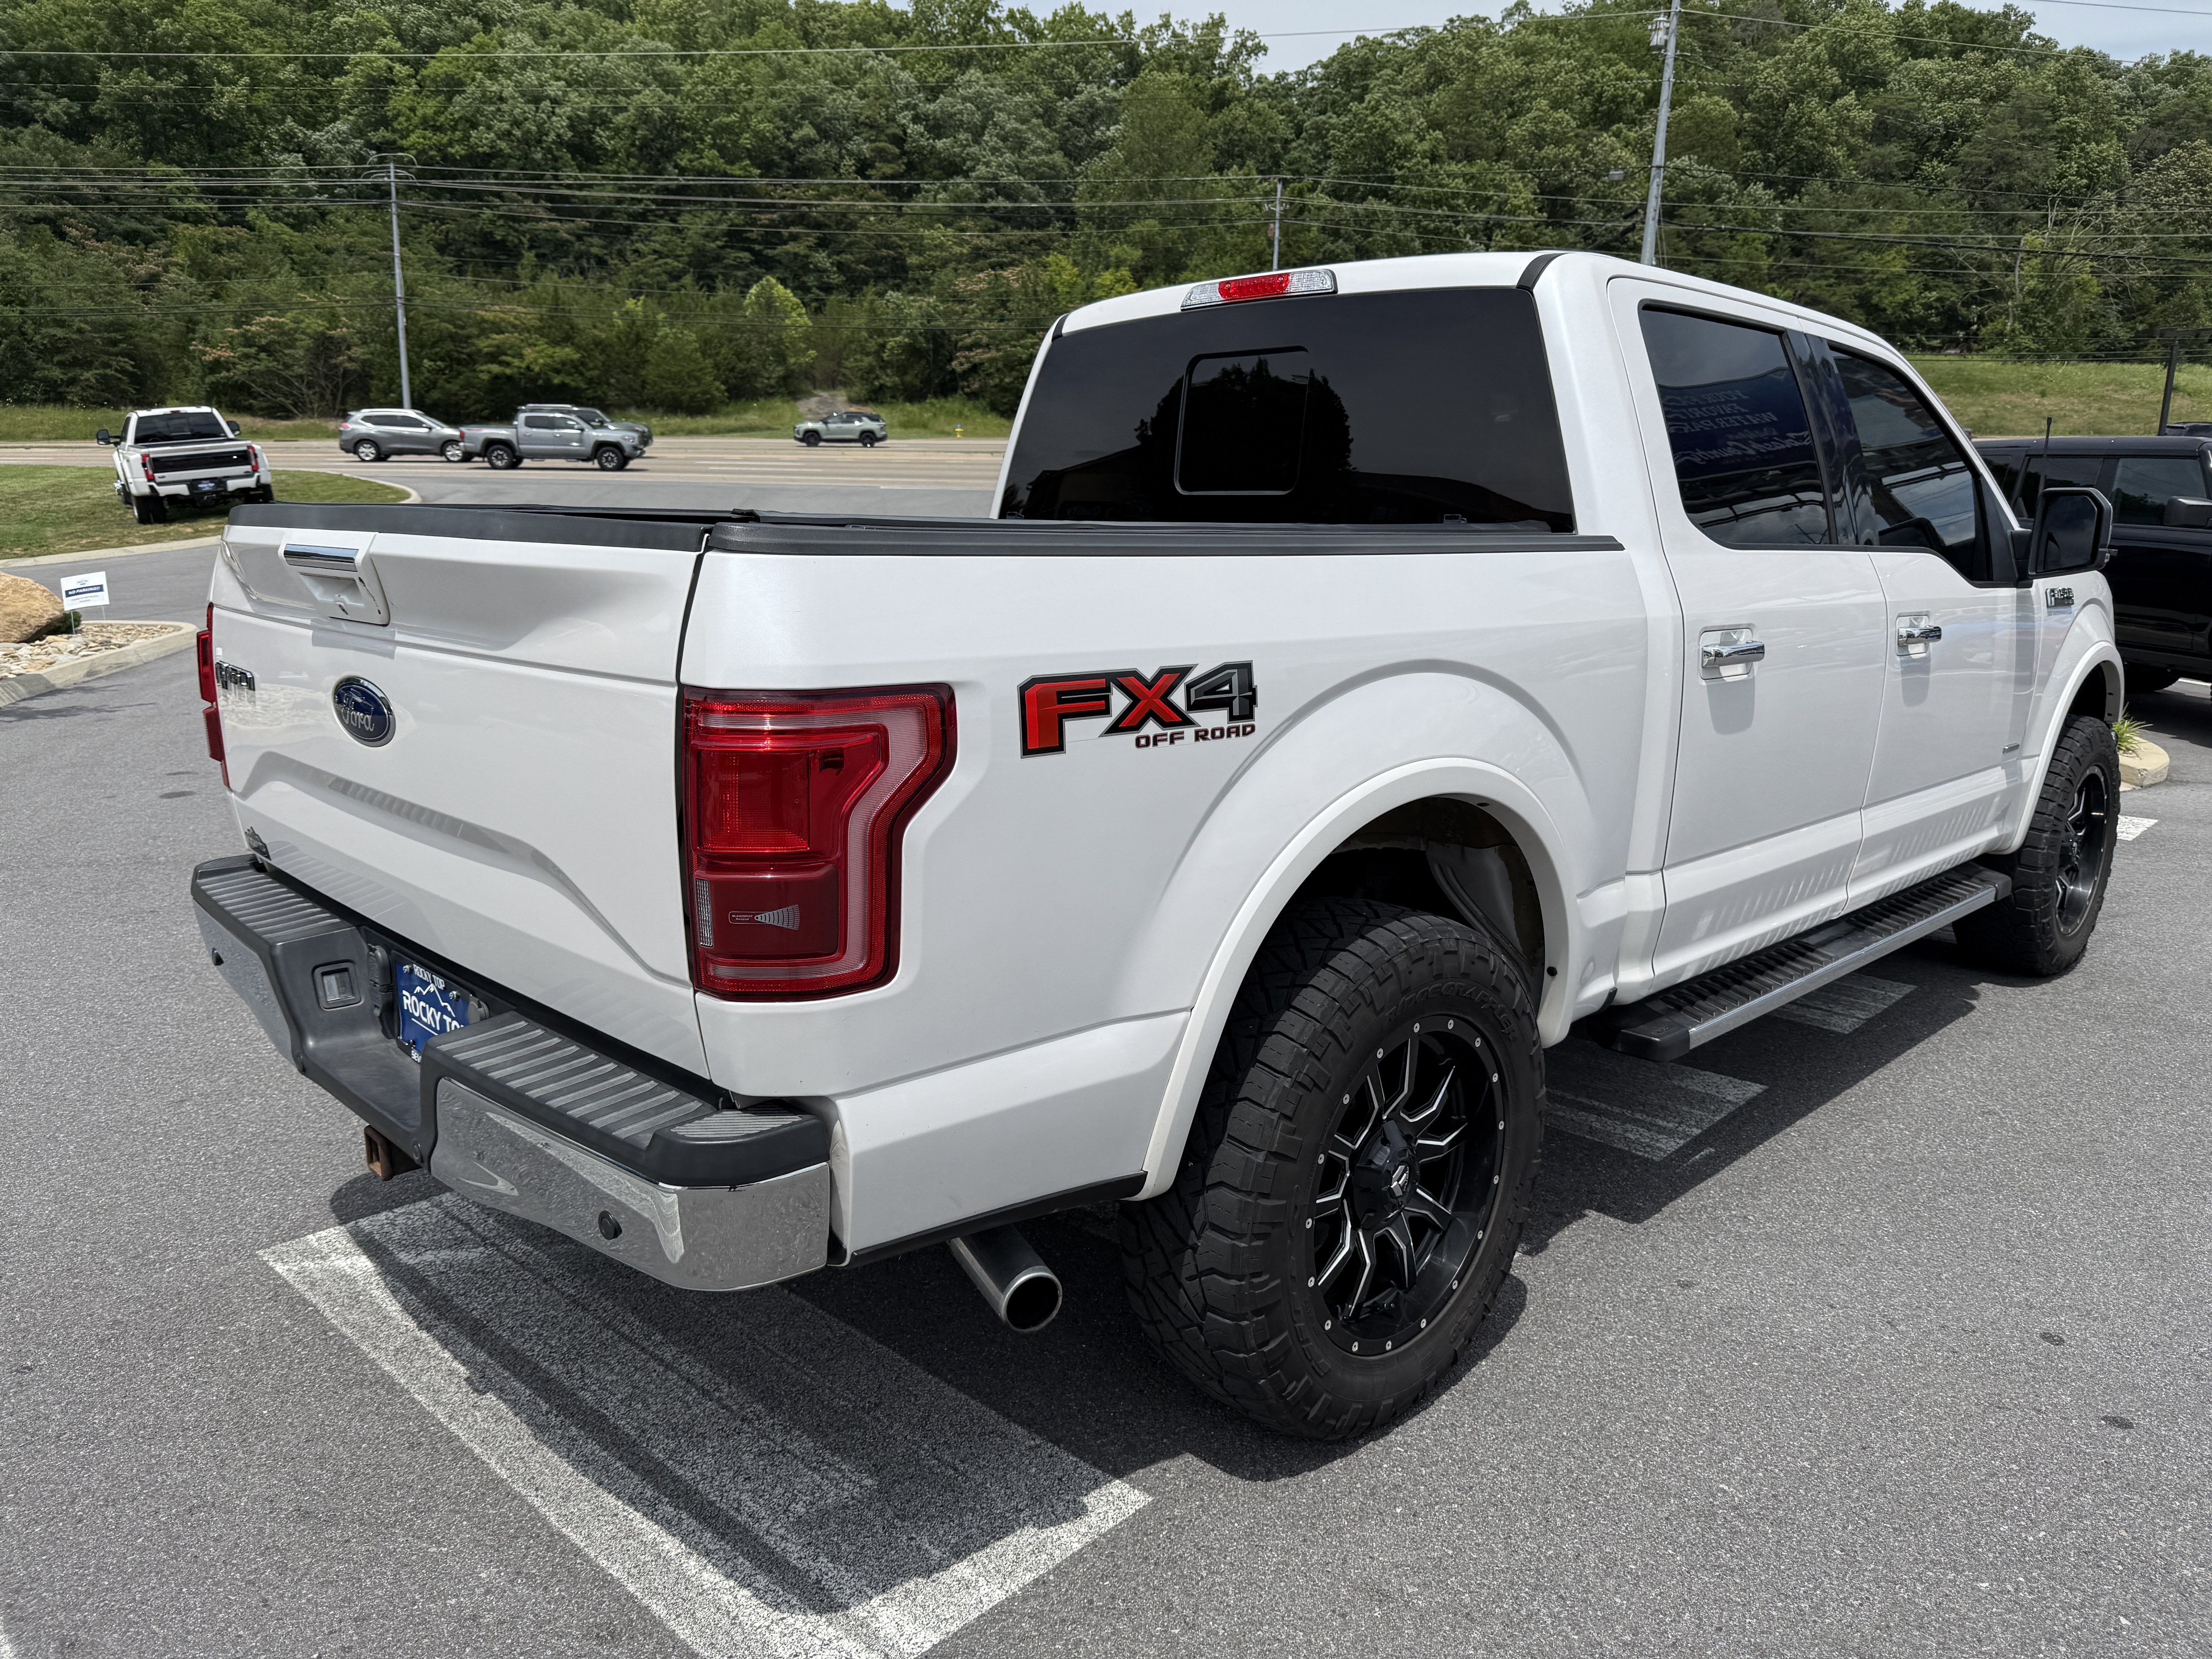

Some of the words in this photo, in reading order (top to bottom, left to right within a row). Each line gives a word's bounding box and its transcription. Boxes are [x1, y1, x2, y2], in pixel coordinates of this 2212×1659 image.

[336, 688, 375, 732] Ford
[1017, 660, 1258, 759] FX4
[1135, 730, 1186, 750] OFF
[1194, 723, 1255, 742] ROAD
[413, 964, 432, 984] ROCKY
[432, 975, 445, 990] TOP
[402, 990, 441, 1030] ROCKY
[443, 1014, 464, 1032] TO
